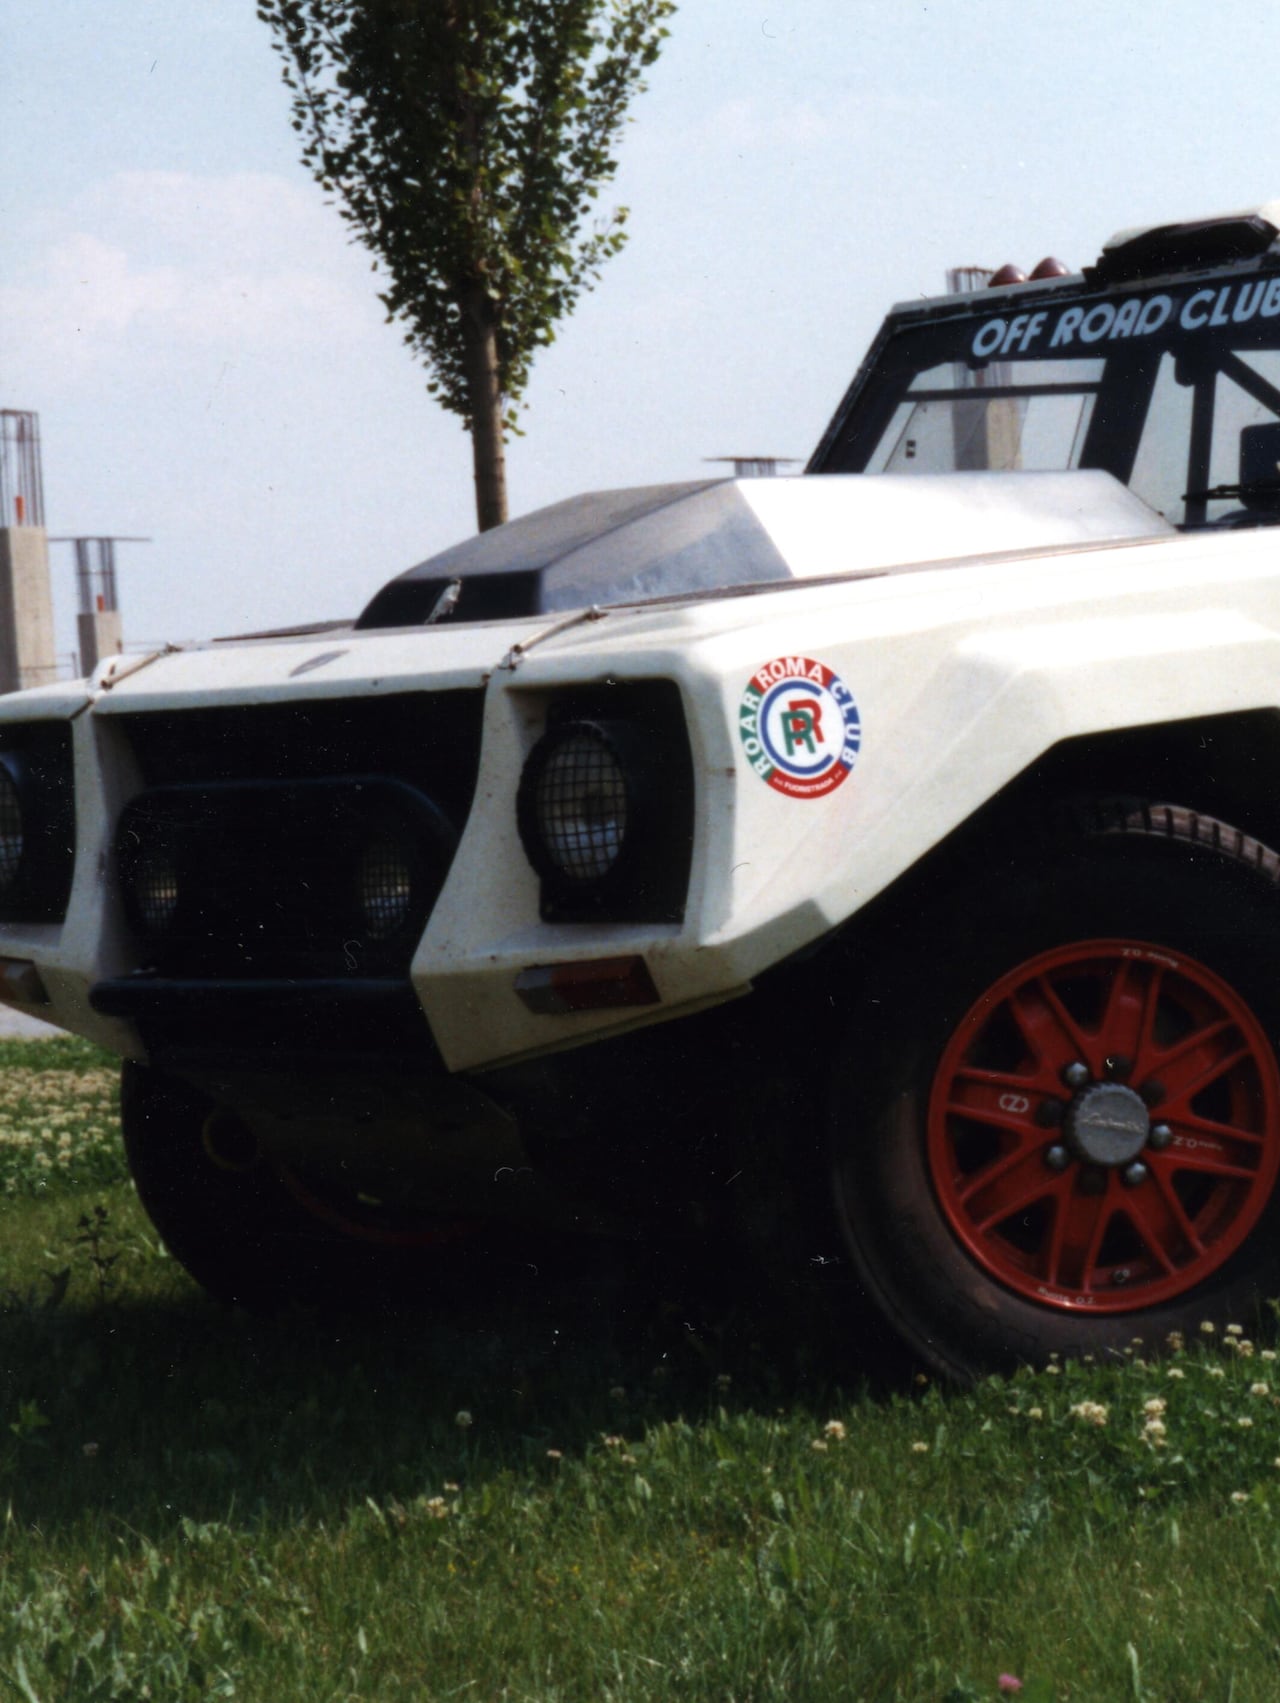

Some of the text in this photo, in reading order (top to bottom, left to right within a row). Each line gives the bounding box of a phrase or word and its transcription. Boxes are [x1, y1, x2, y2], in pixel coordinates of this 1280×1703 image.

[972, 312, 1050, 357] OFF
[1050, 295, 1172, 348] ROAD
[739, 656, 861, 776] ROAR ROMA CLUB
